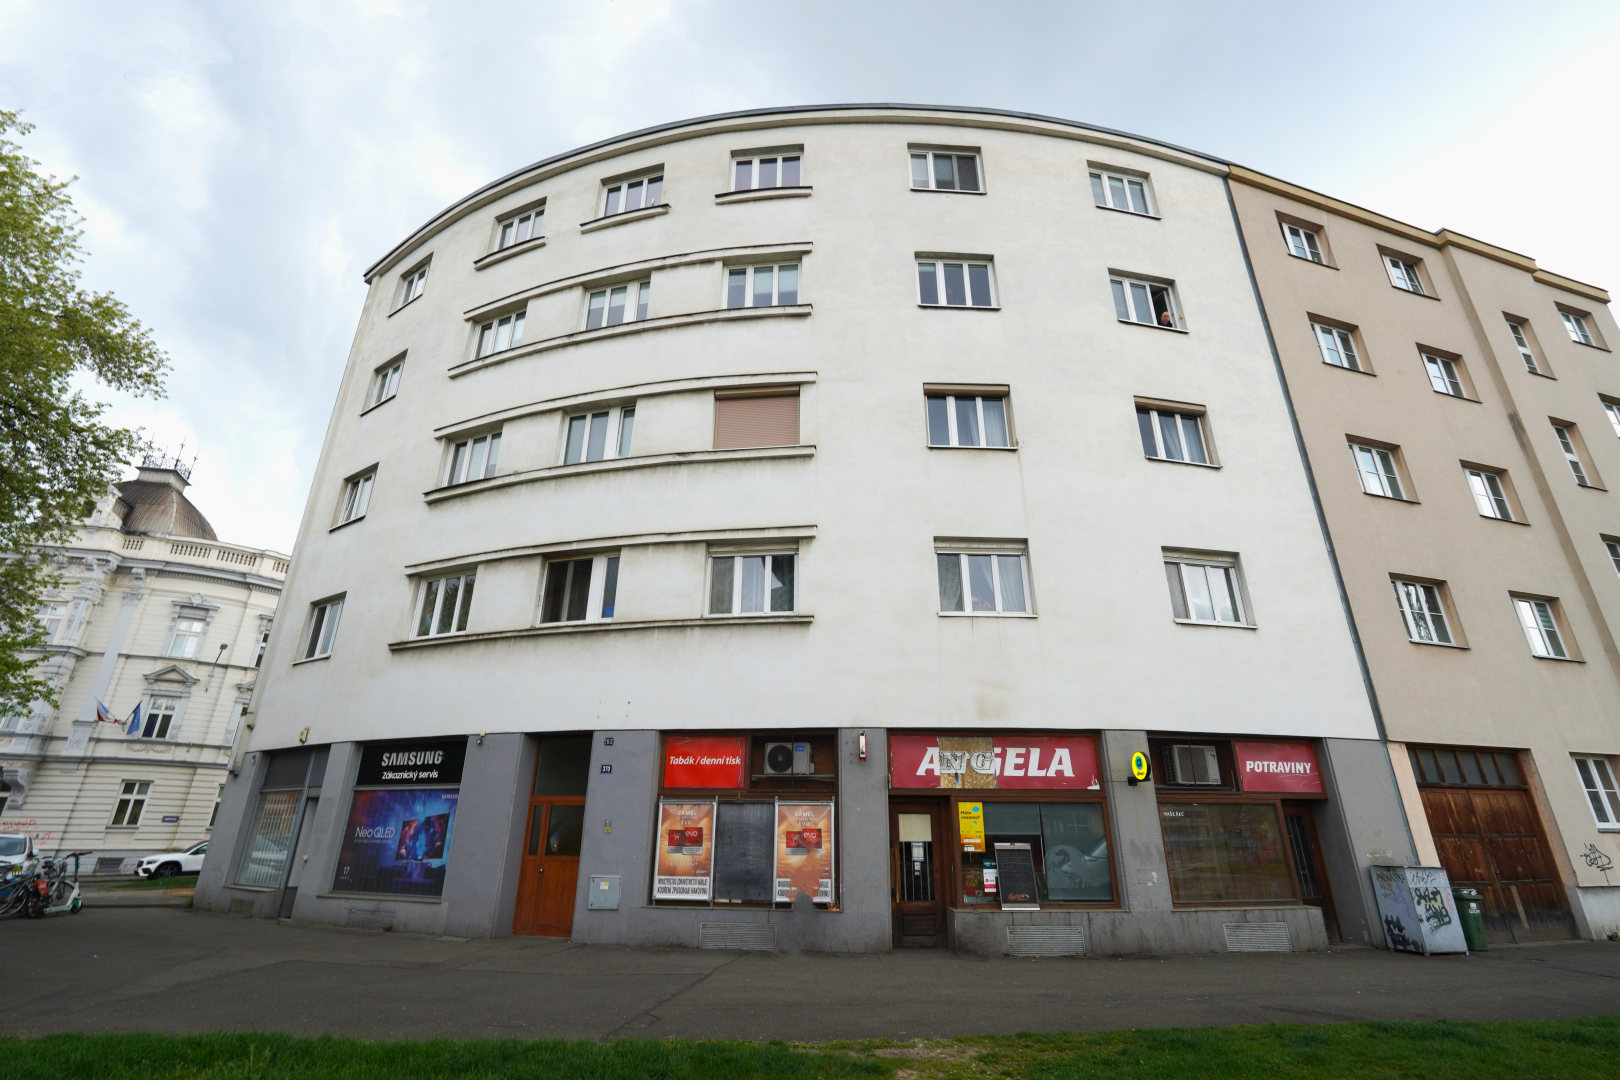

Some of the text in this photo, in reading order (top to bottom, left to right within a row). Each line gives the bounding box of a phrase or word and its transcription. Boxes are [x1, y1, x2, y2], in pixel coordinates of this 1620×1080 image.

[381, 750, 443, 767] SAMSUNG
[669, 755, 695, 765] Tabák
[700, 755, 725, 765] denní
[725, 755, 741, 765] tisk
[1245, 759, 1312, 775] POTRAVINY
[381, 769, 439, 781] Zákaznický servis
[355, 826, 395, 838] Neo QLED
